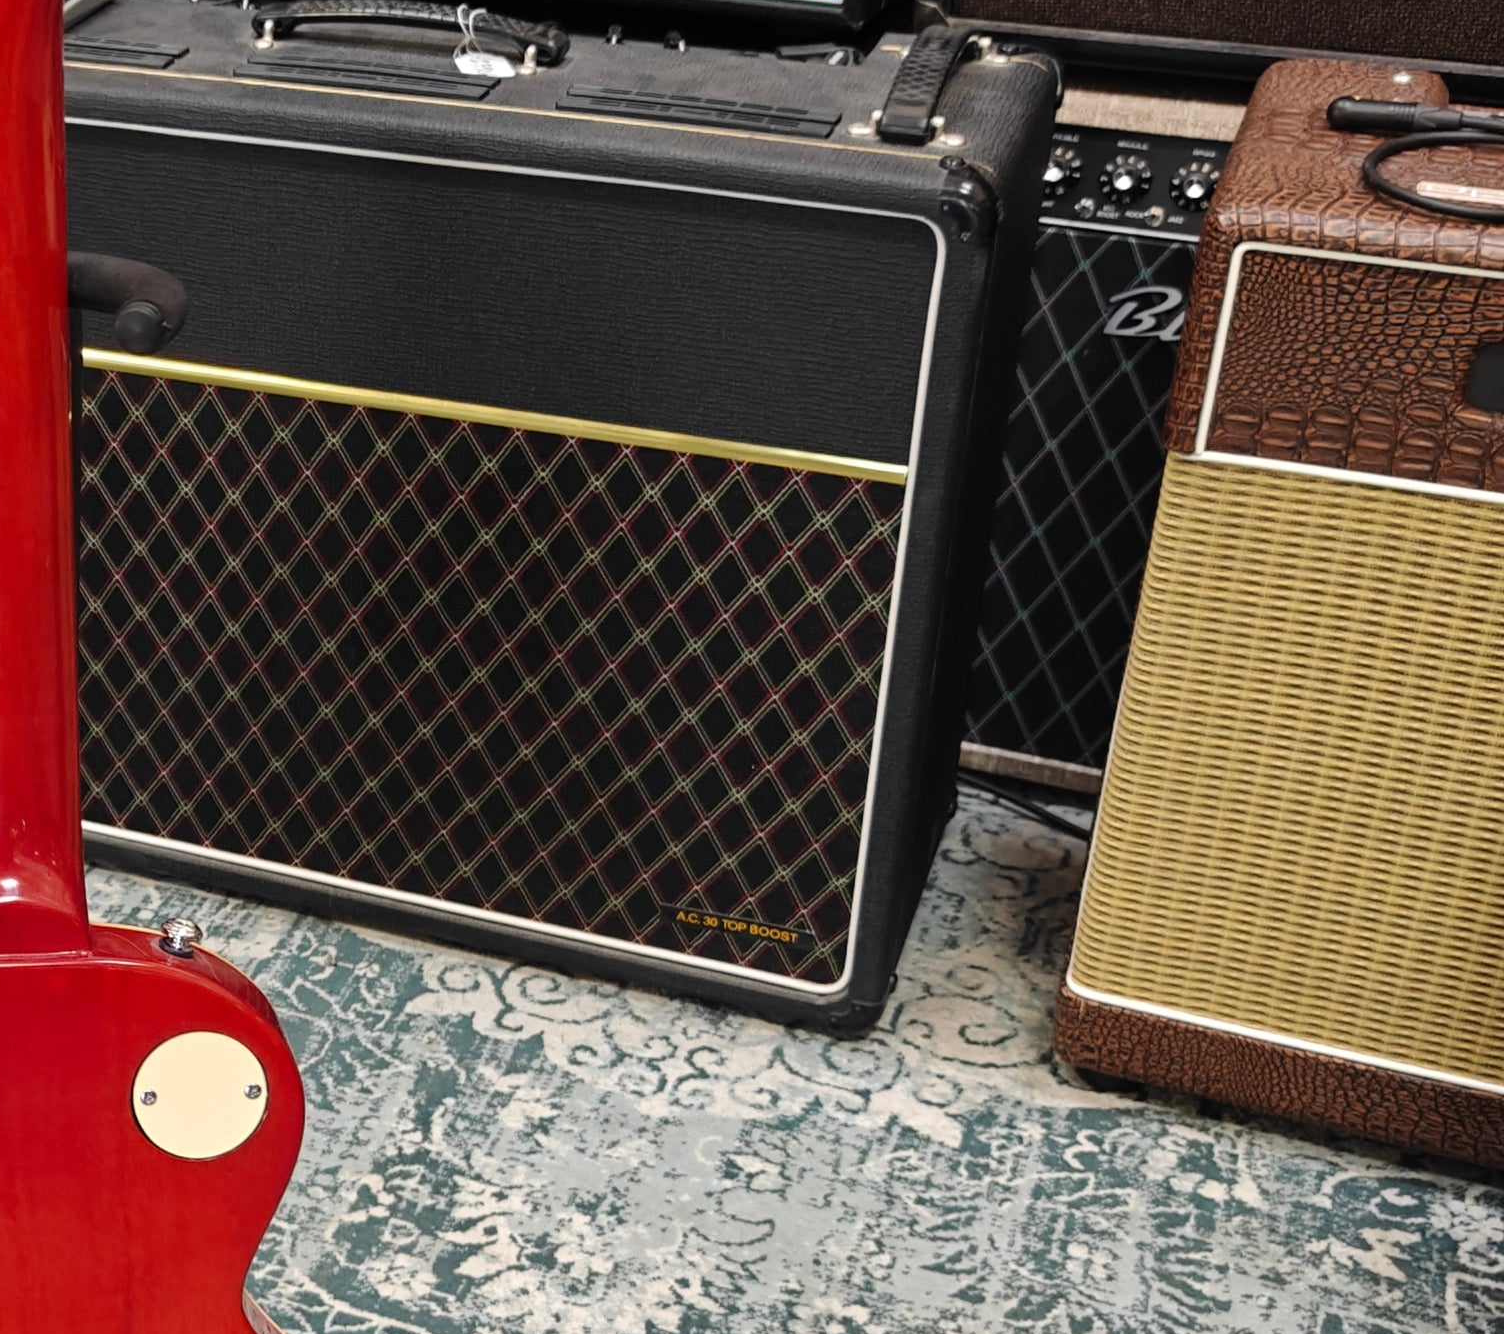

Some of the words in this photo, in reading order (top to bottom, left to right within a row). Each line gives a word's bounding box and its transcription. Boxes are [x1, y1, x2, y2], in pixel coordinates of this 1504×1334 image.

[703, 915, 719, 928] 30
[722, 918, 747, 933] TOP
[749, 924, 799, 944] BOOST
